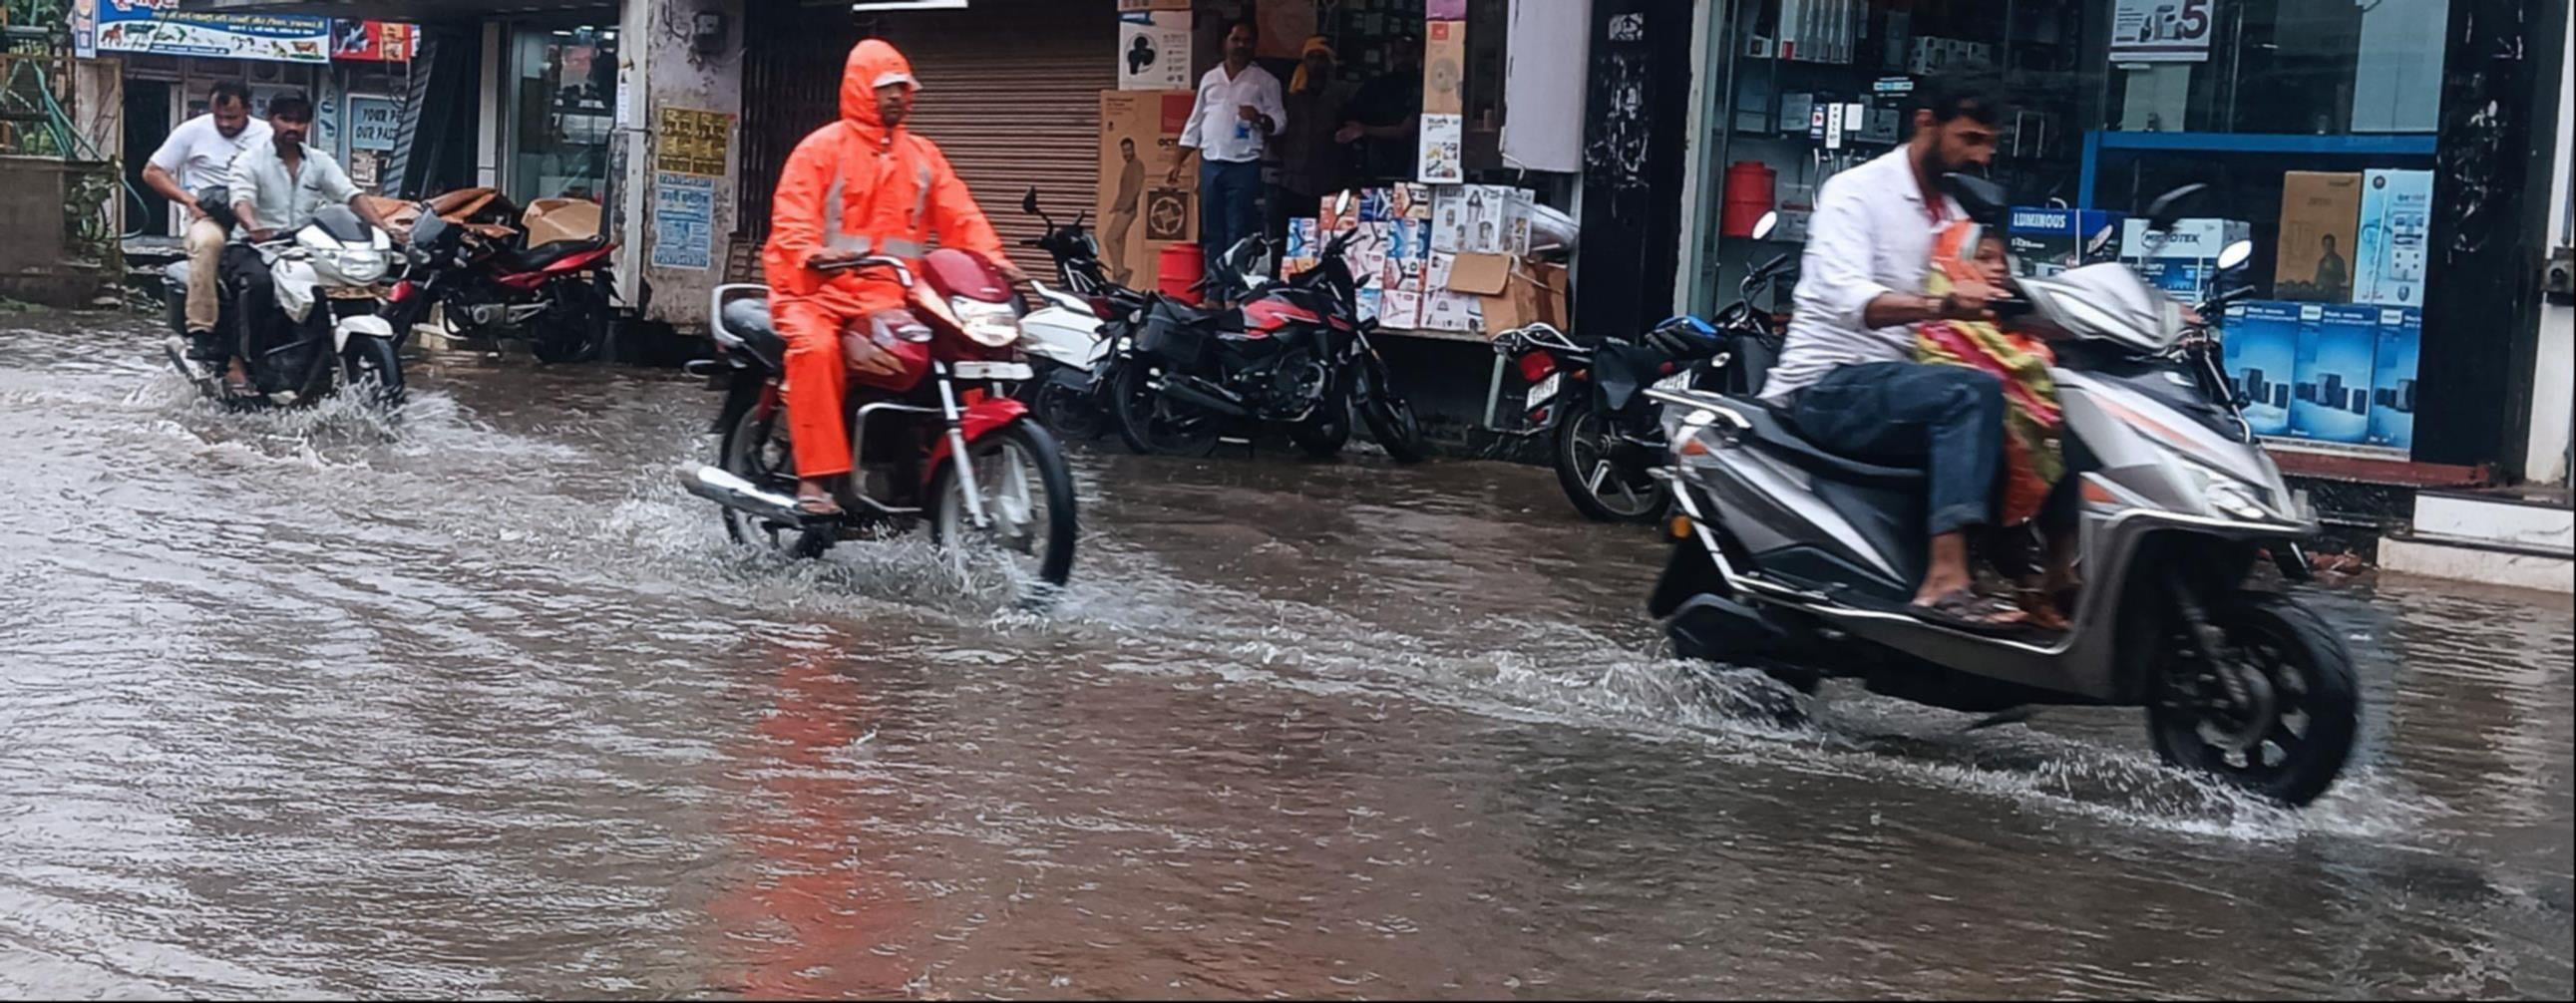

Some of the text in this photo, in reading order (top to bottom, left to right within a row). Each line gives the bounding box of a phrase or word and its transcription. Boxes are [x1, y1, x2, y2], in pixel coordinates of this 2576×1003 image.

[362, 108, 387, 123] YOUR
[356, 125, 375, 140] OUR
[2013, 211, 2067, 228] LUMINOUS
